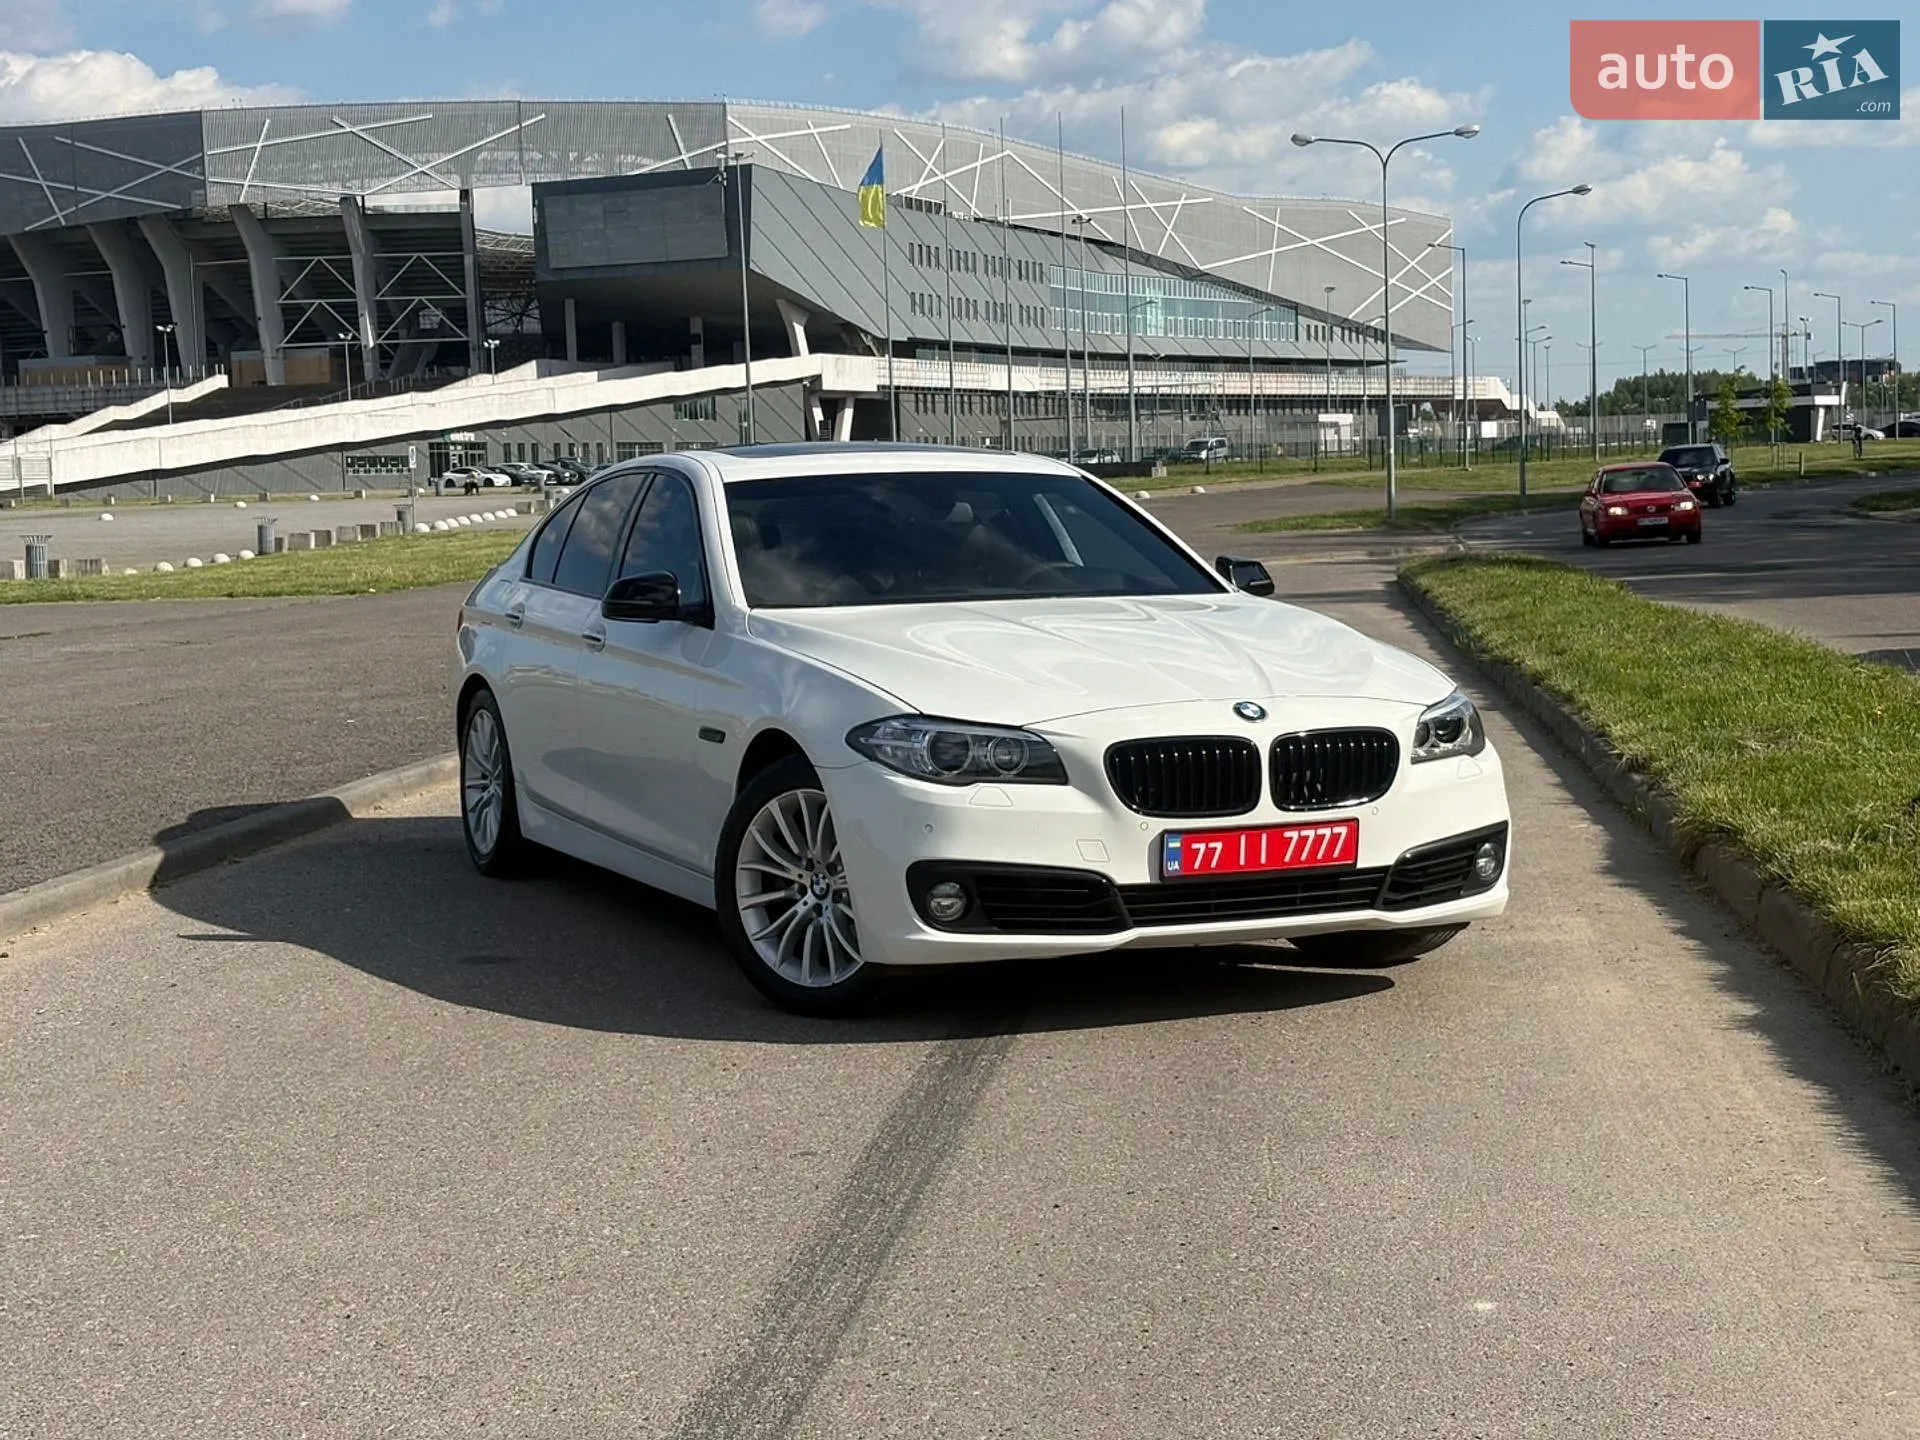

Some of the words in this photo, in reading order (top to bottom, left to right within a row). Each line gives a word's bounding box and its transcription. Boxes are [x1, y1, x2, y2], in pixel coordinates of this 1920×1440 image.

[1191, 841, 1223, 870] 77
[1283, 826, 1348, 863] 7777
[1167, 860, 1180, 871] UA
